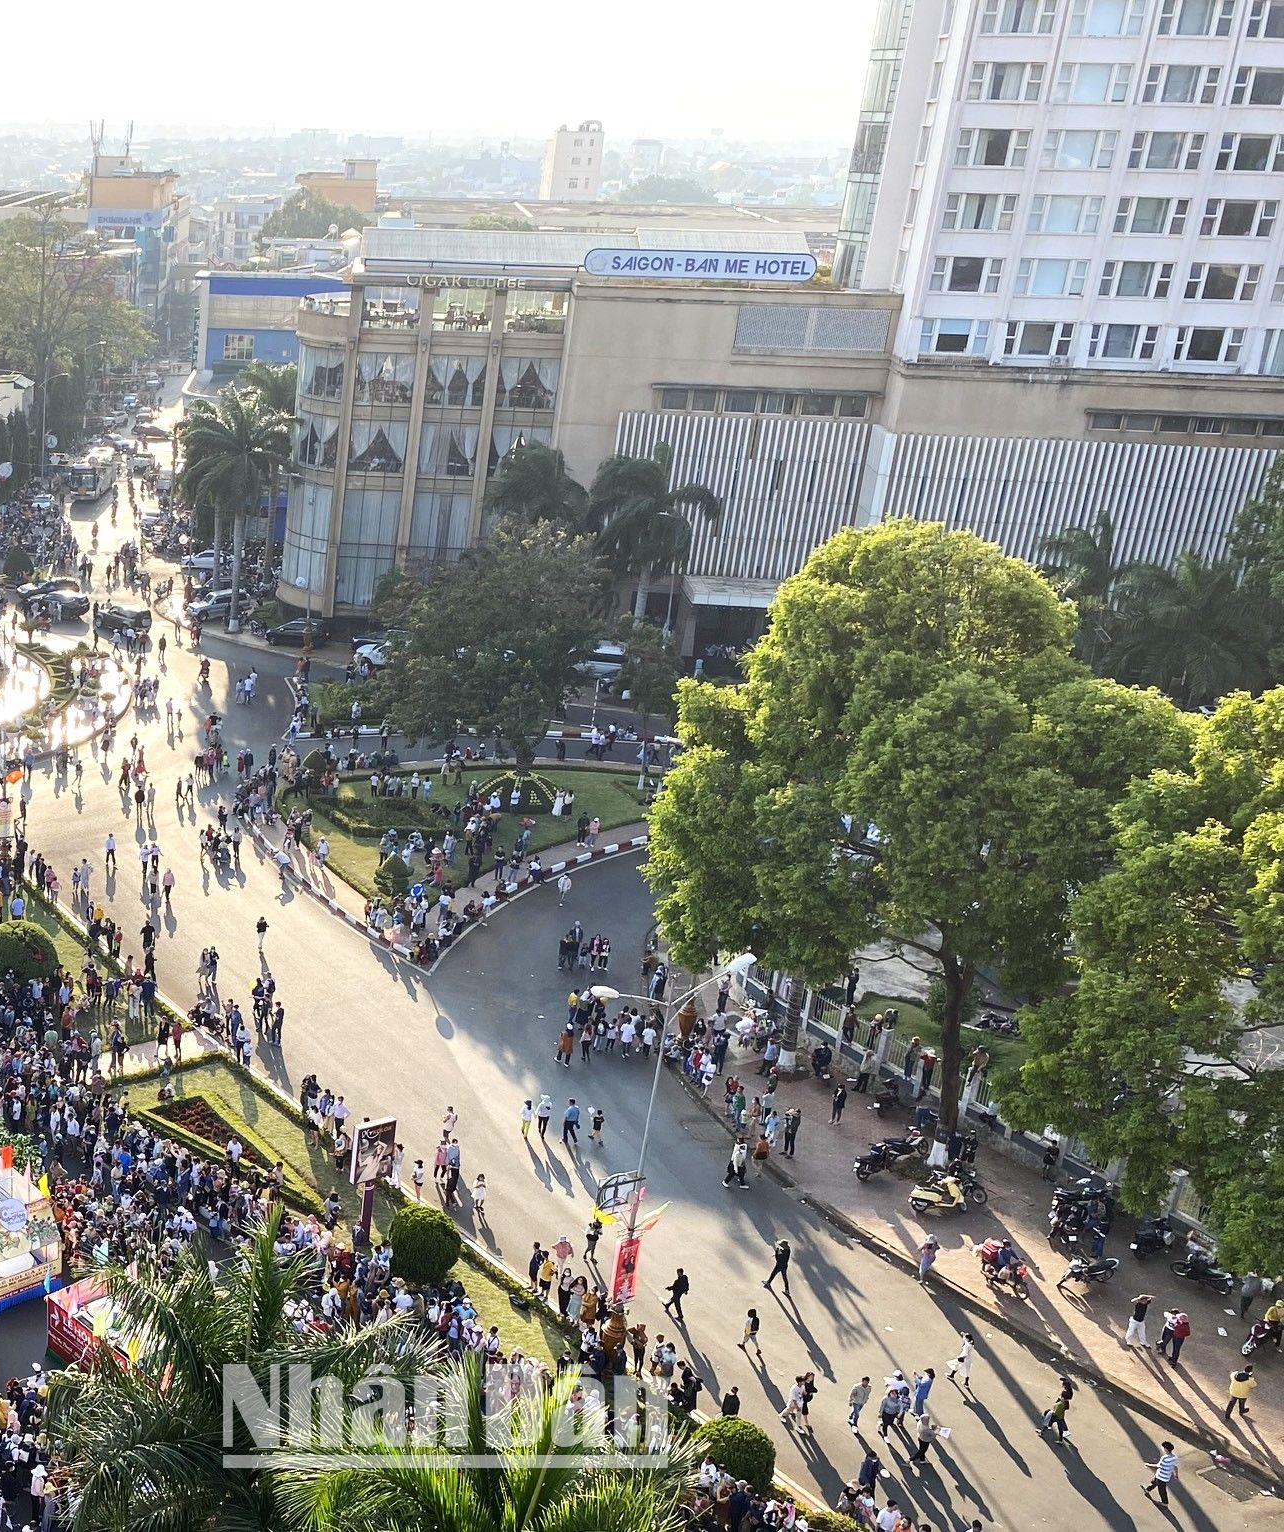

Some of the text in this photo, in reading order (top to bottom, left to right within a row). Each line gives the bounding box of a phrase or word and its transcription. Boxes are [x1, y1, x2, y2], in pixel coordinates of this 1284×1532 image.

[724, 260, 750, 274] ME
[754, 260, 811, 276] HOTEL
[406, 274, 462, 287] CIGAR
